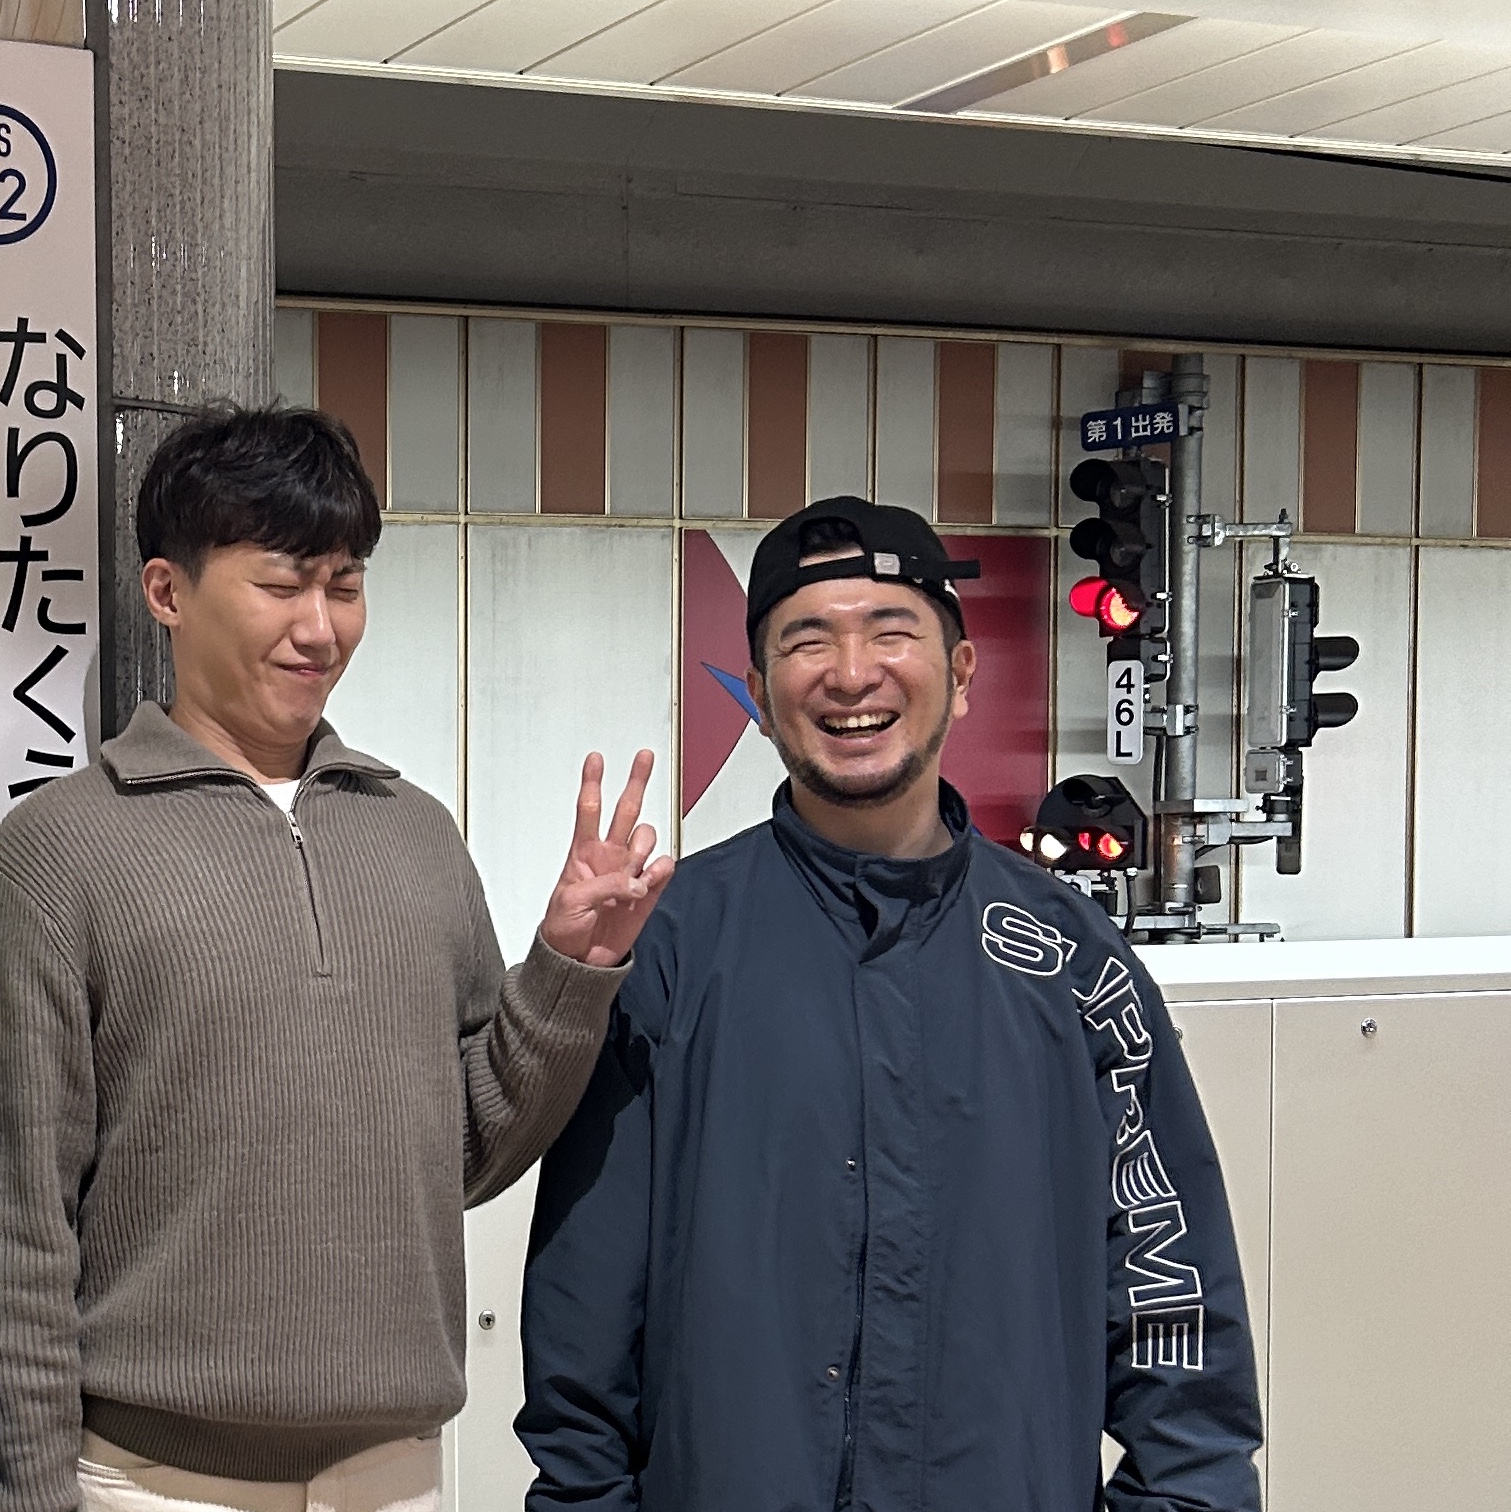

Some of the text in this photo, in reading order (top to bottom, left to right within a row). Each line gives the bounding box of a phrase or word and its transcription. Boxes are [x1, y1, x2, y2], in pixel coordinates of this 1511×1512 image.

[1086, 411, 1174, 443] 第1出発
[1114, 667, 1136, 757] 46L
